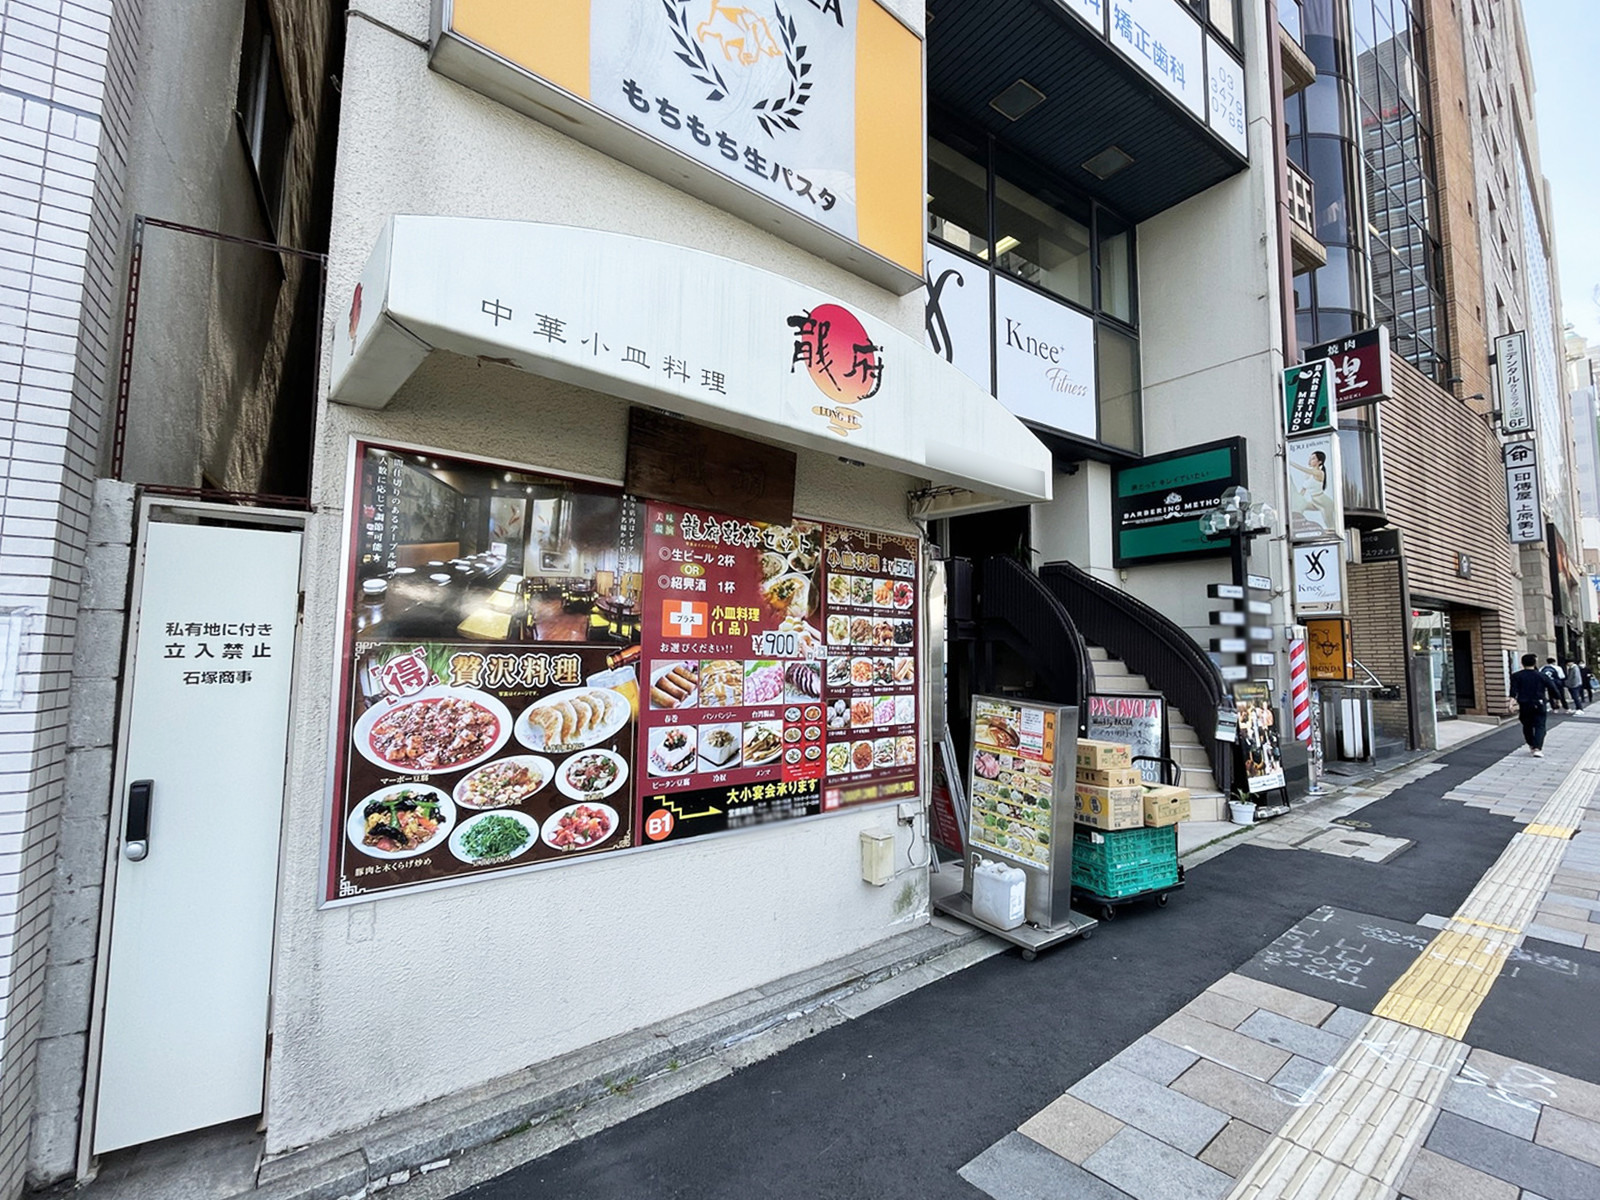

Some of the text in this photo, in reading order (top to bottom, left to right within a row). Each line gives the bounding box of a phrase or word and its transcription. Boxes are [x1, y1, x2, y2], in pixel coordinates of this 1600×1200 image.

[1114, 3, 1186, 90] 矯正歯科
[1219, 67, 1234, 90] 03
[1211, 96, 1244, 134] 0788
[622, 79, 837, 212] もちもち生パスタ
[481, 298, 727, 395] 中華小皿料理
[1327, 339, 1356, 356] 焼肉
[1045, 367, 1089, 397] Fitness
[1303, 364, 1323, 425] BARBERING
[819, 406, 844, 422] LONG
[1291, 391, 1307, 431] METHOD
[1509, 417, 1525, 428] 6F
[1511, 449, 1528, 462] 印
[1123, 505, 1181, 520] BARBERING
[680, 512, 813, 553] 龍府乾杯セット
[671, 548, 736, 568] 生ビール 2杯
[827, 548, 880, 573] 小皿料理
[684, 565, 701, 575] OR
[670, 577, 736, 594] 紹興酒 1杯
[677, 615, 696, 624] プラス
[711, 606, 760, 622] 小皿料理
[165, 621, 273, 637] 私有地に付き
[164, 642, 272, 660] 立入禁止
[183, 670, 253, 686] 石塚商事
[383, 654, 581, 697] 得 贅沢料理
[1311, 664, 1342, 673] HONDA
[755, 769, 771, 777] メンマ
[726, 779, 819, 805] 大小宴会承ります
[649, 816, 672, 836] B1
